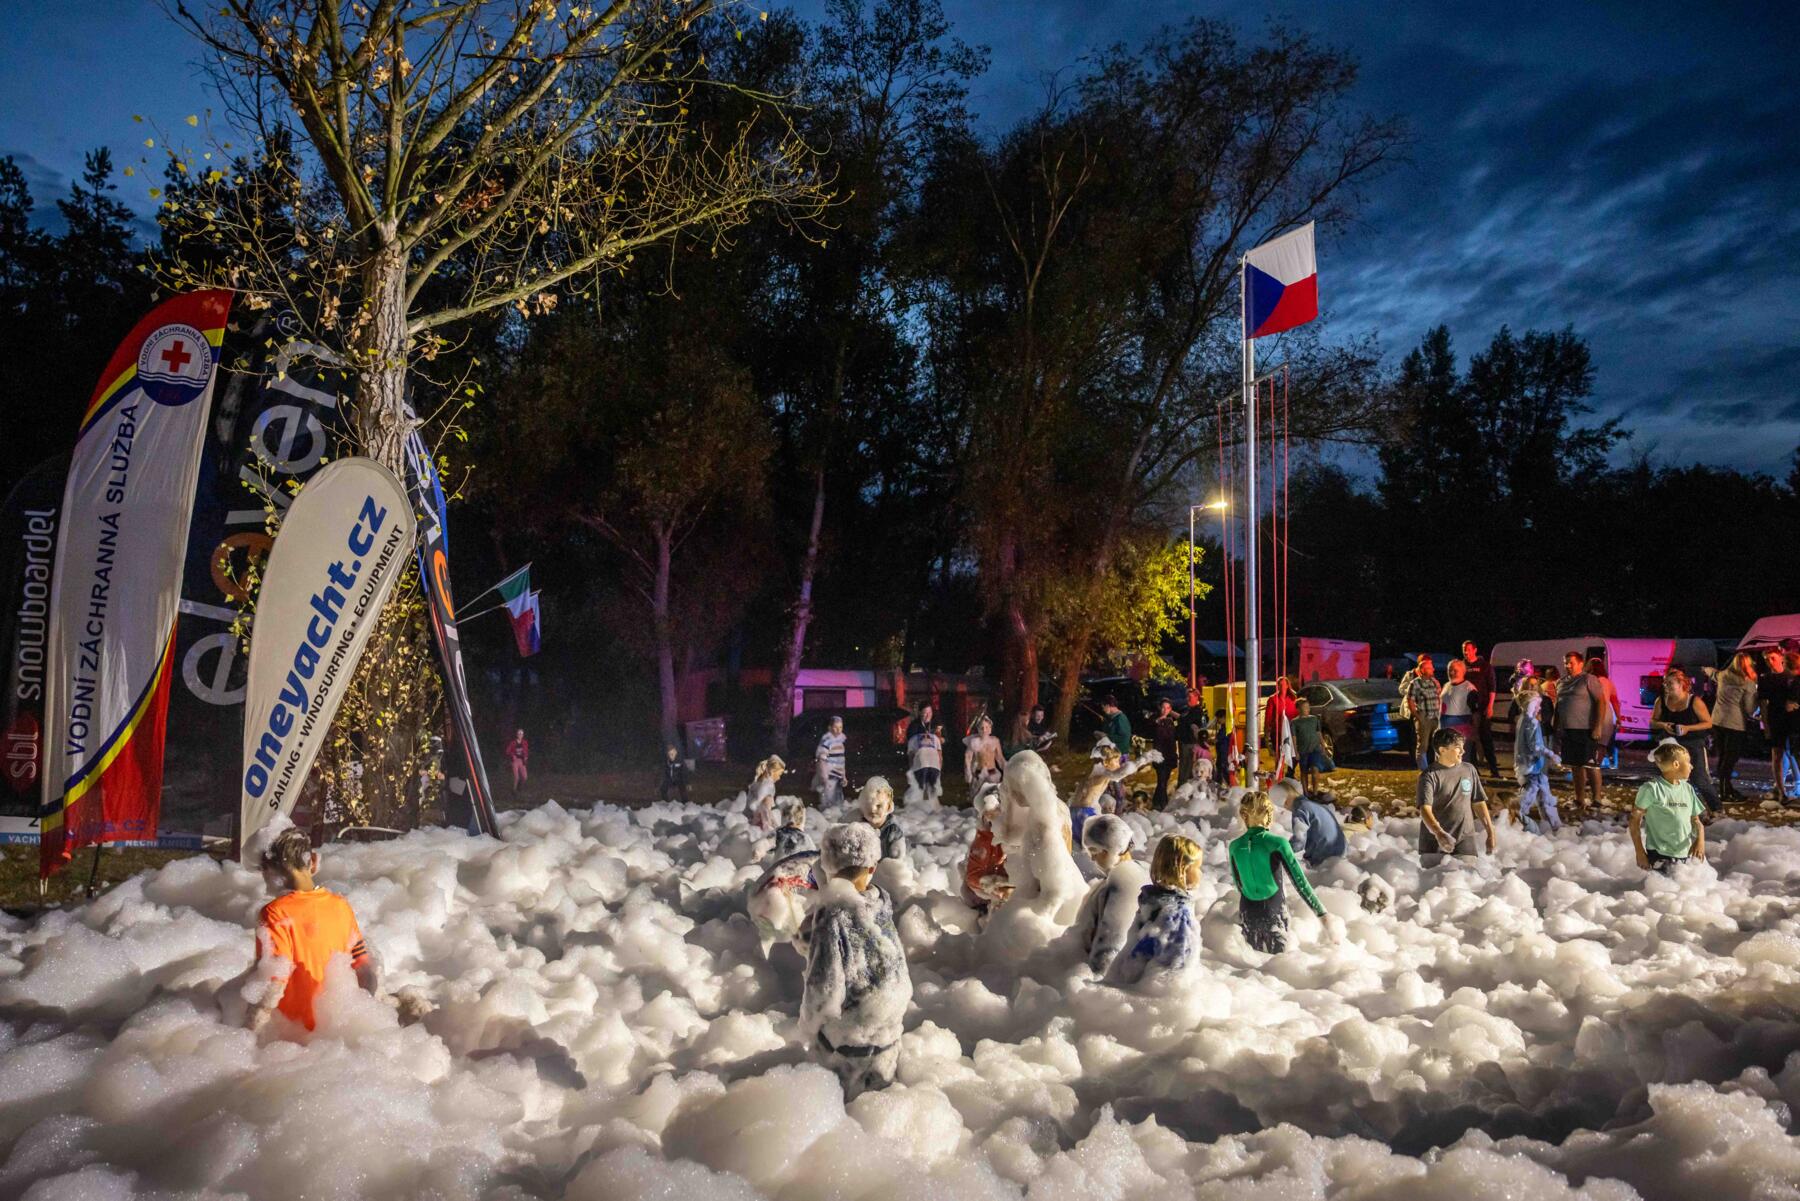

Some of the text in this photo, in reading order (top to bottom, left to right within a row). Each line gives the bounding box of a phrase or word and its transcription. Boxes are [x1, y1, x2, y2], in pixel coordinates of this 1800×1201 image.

[66, 403, 139, 756] VODNÍ ZÁCHRANNÁ SLUŽBA
[244, 494, 388, 798] oneyacht.cz
[269, 523, 404, 810] SAILING WINDSURFING EQUIPMENT
[7, 732, 39, 779] sbl
